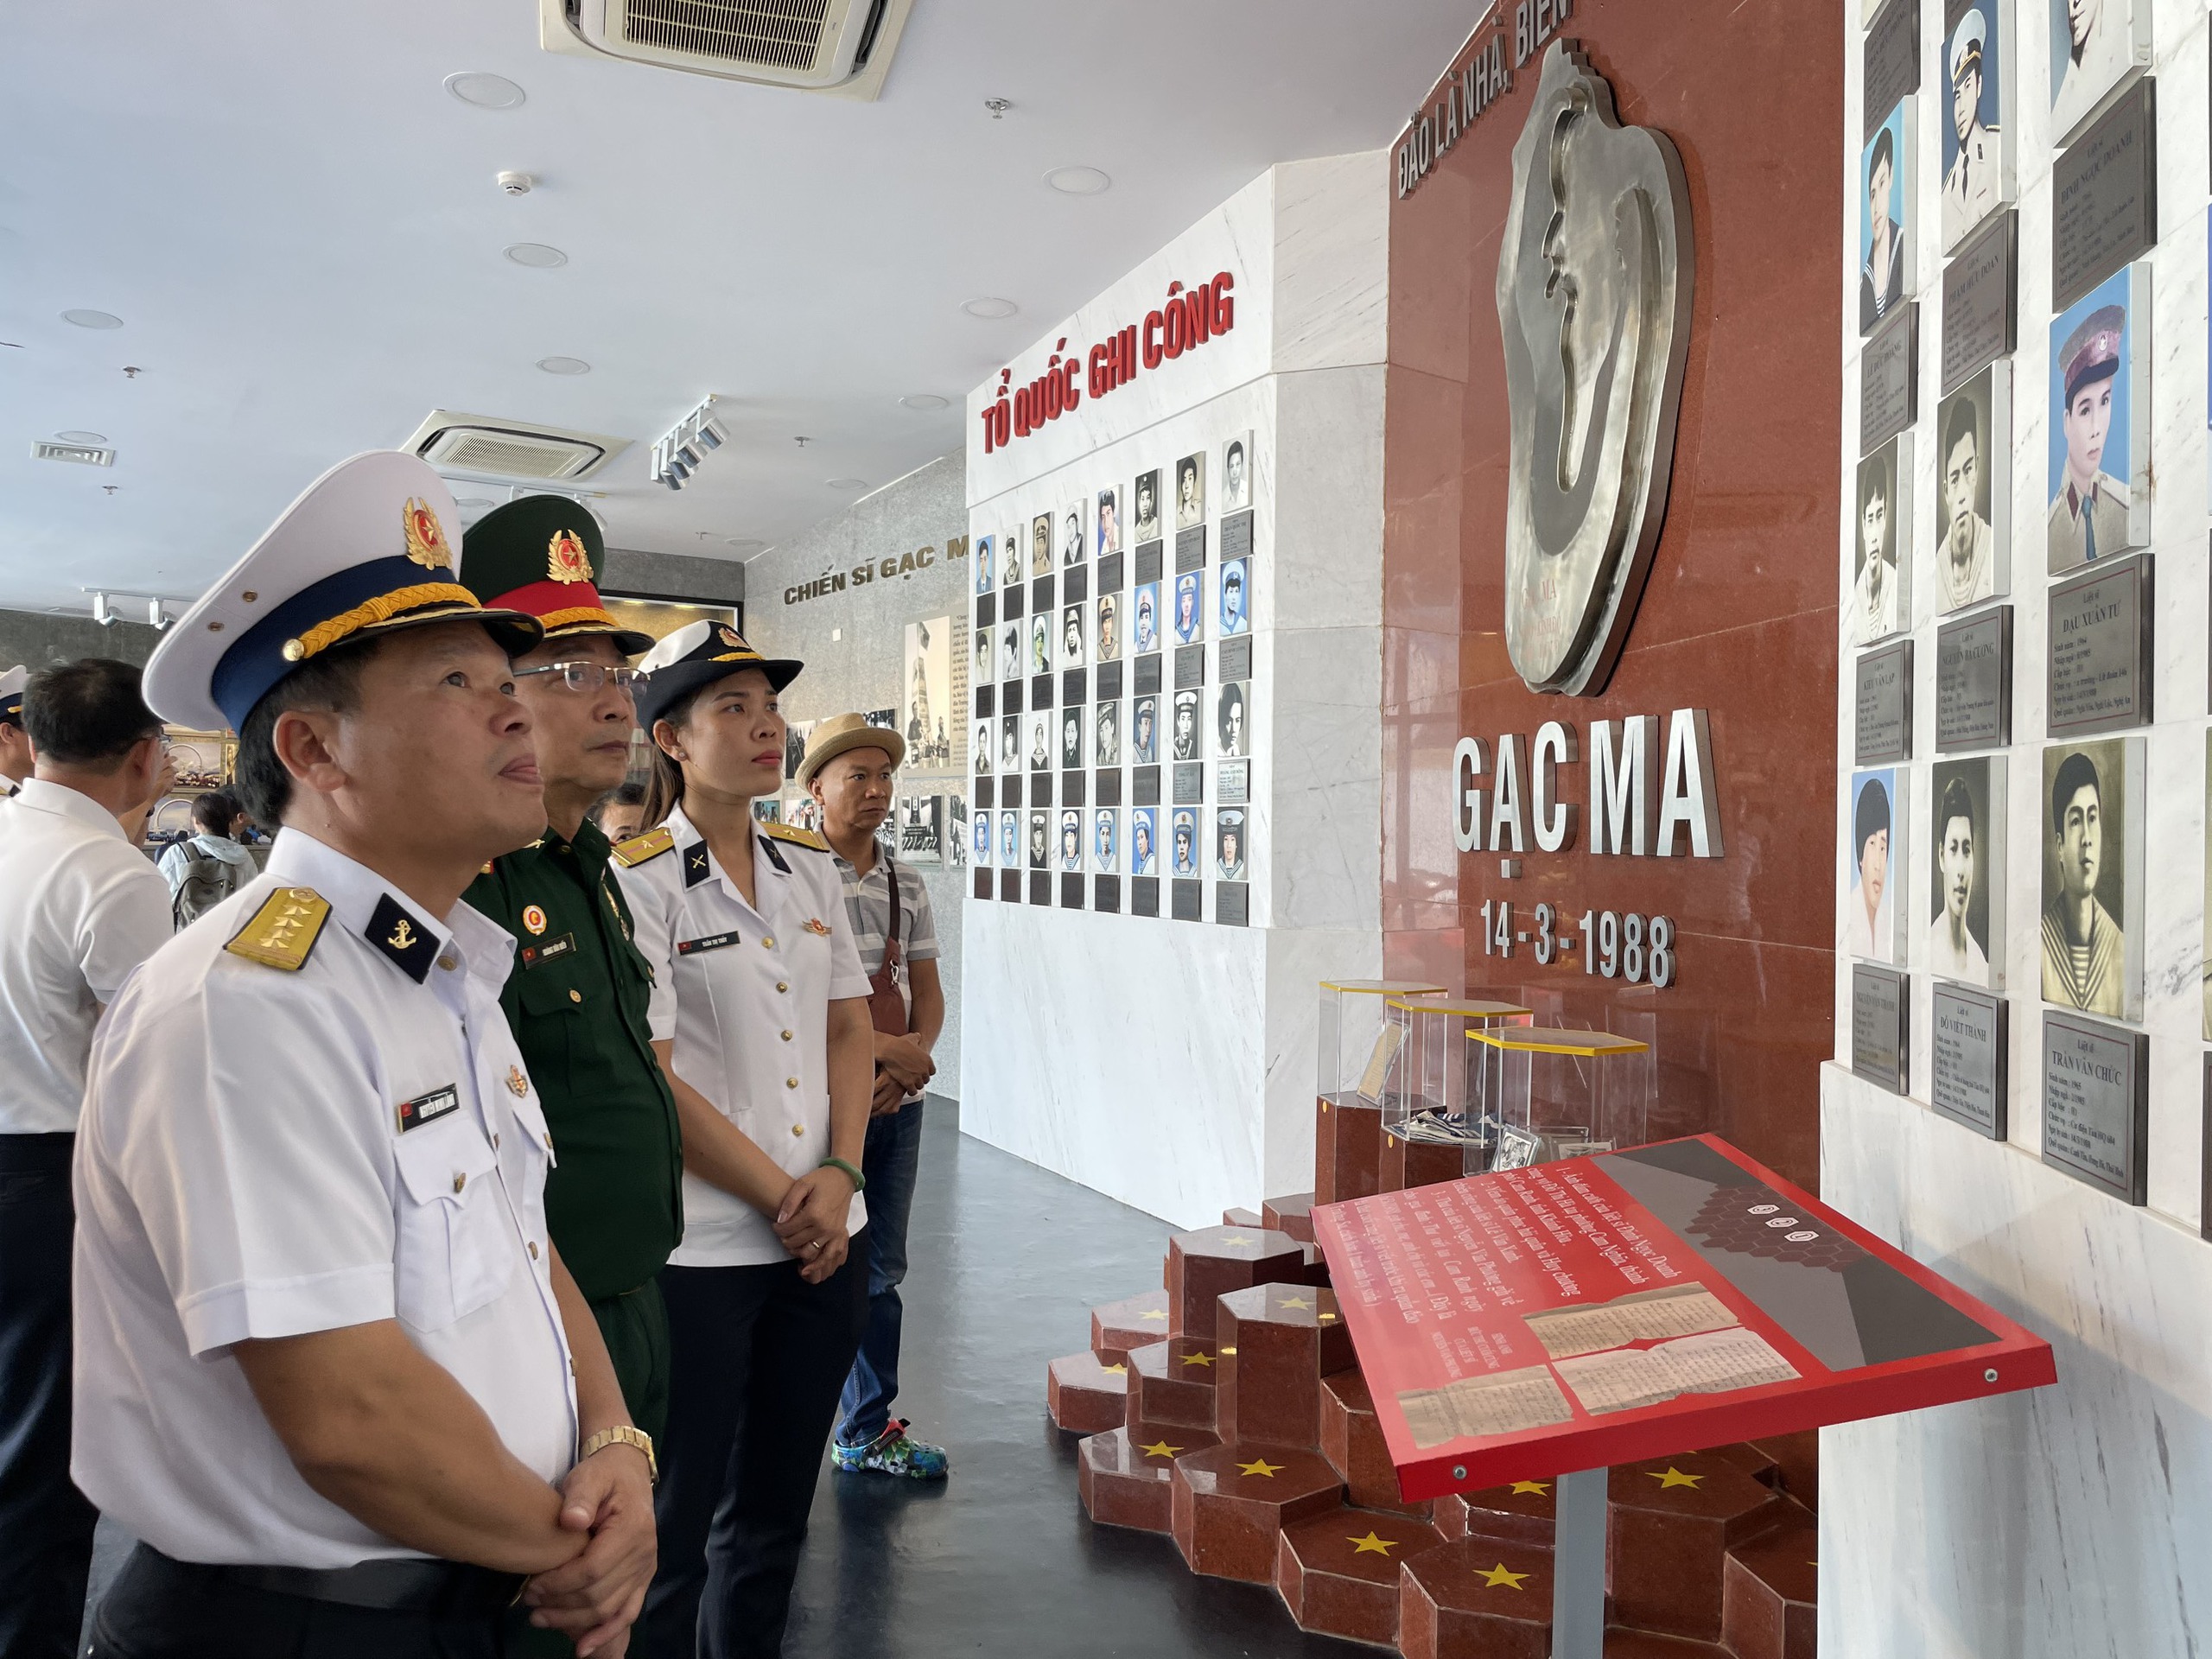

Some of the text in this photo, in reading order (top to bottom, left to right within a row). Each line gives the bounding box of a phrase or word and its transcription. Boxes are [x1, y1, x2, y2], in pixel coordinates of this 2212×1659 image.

[1399, 111, 1433, 200] ĐẢO
[1435, 70, 1462, 159] LÀ
[1463, 15, 1513, 130] NHÀ,
[982, 271, 1234, 454] TỔ QUỐC GHI CÔNG
[784, 534, 969, 605] CHIẾN SĨ GẠC M
[2082, 604, 2106, 626] XUÂN
[1452, 721, 1579, 879] GẠC
[1590, 708, 1725, 858] MA
[1481, 899, 1676, 988] 14-3-1988
[1941, 1014, 1949, 1029] ĐỖ
[1965, 1024, 1986, 1042] THÀNH
[2077, 1039, 2088, 1053] Liệt
[2052, 1051, 2121, 1085] TRẦN VĂN CHỨC
[1509, 1179, 1526, 1192] Cam
[1538, 1213, 1564, 1231] Khánh
[1453, 1228, 1484, 1250] Nguyễn
[1491, 1233, 1509, 1246] Văn
[1541, 1183, 1564, 1192] Đỗ
[1565, 1214, 1596, 1234] phường
[1588, 1231, 1609, 1246] Cam
[1599, 1244, 1629, 1266] Nghĩa,
[1619, 1265, 1649, 1284] thành
[1601, 1211, 1622, 1222] liệt
[1617, 1225, 1643, 1241] Đinh
[1630, 1239, 1656, 1256] Ngọc
[1647, 1255, 1681, 1278] Doanh
[1471, 1249, 1488, 1262] Văn
[1536, 1250, 1555, 1259] và
[1541, 1257, 1561, 1272] Huy
[1477, 1262, 1501, 1286] Phương
[1553, 1272, 1580, 1297] chương
[1486, 1285, 1515, 1297] gửi
[1500, 1296, 1524, 1306] về
